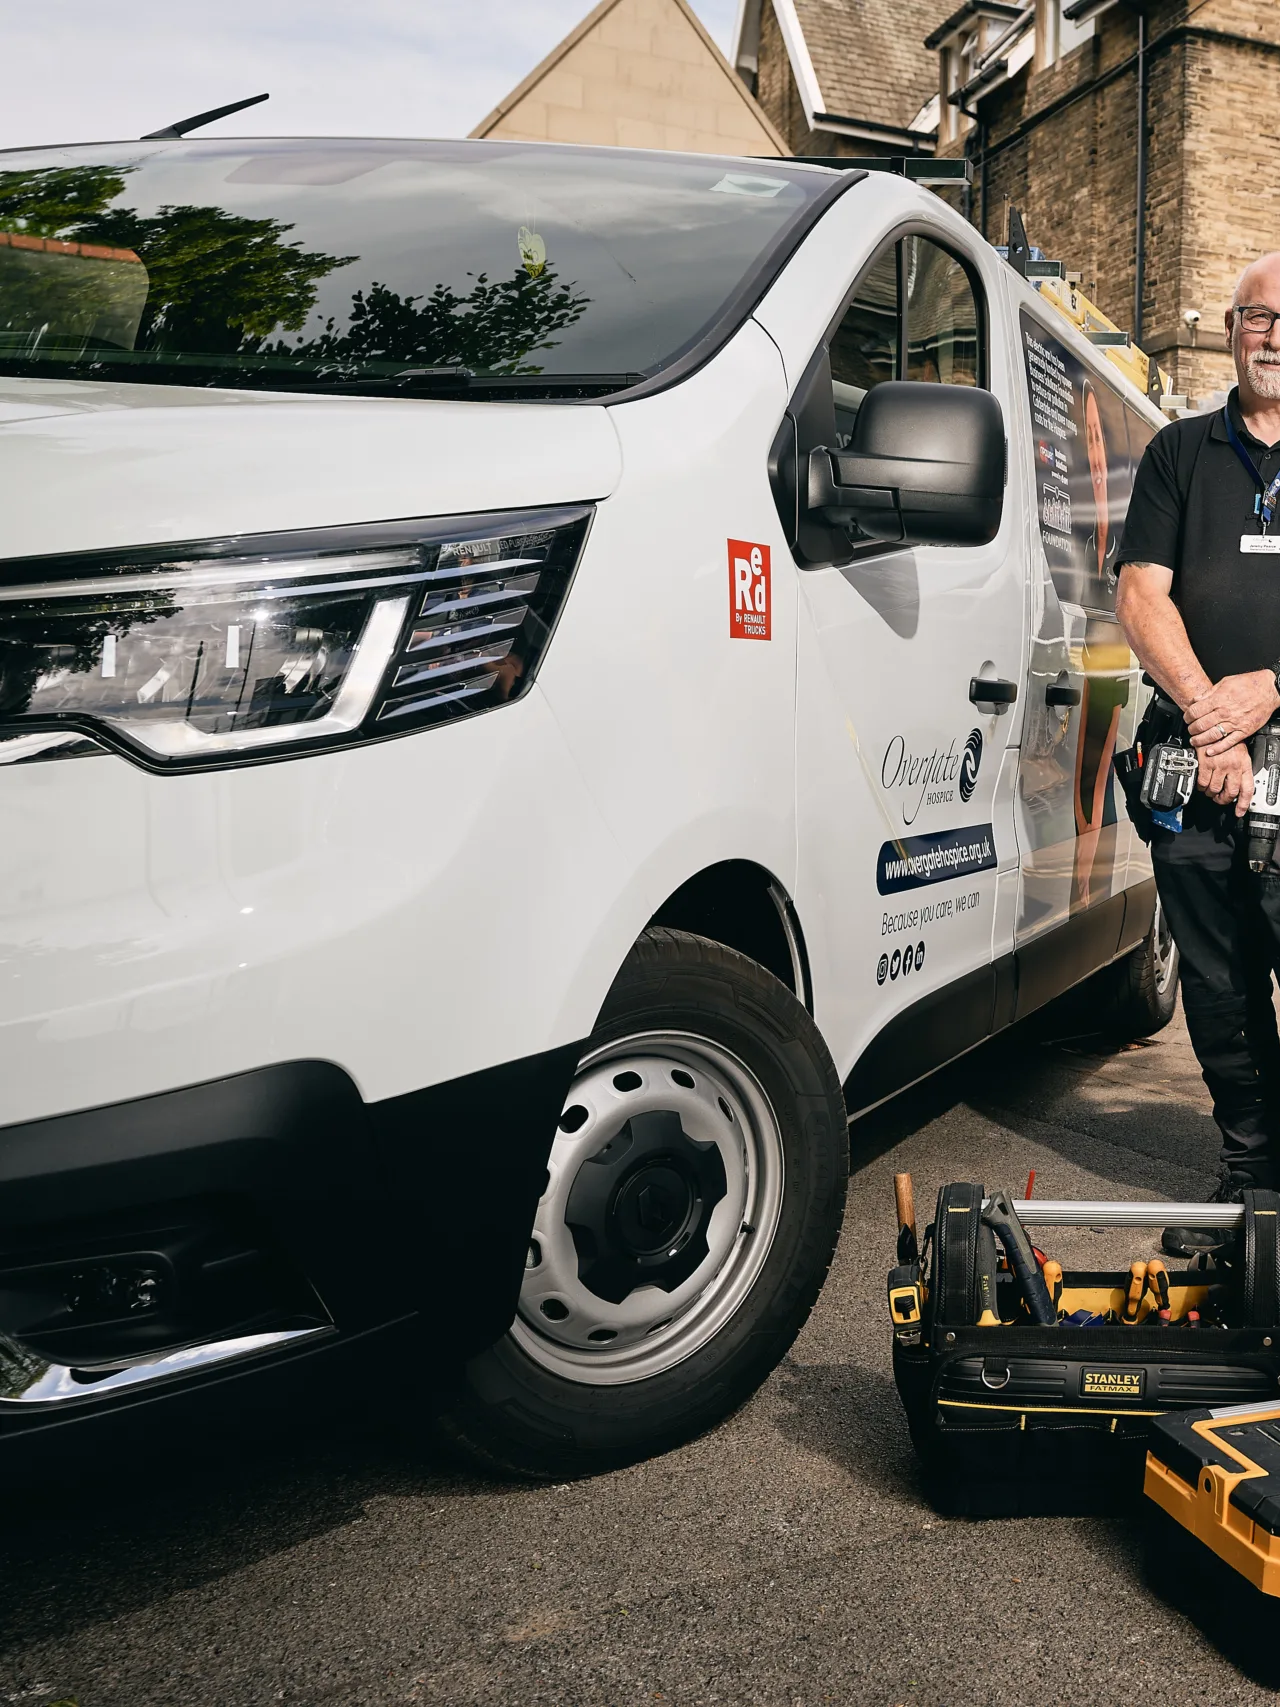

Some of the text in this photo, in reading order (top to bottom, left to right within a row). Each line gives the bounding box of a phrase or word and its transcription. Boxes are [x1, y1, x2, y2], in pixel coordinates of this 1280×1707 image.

[453, 542, 491, 556] RENAULT
[735, 612, 766, 625] By RENAULT
[744, 625, 766, 635] TRUCKS
[882, 735, 960, 826] Overgate
[926, 790, 954, 805] HOSPICE
[885, 836, 992, 880] www.overgatehospice.org.uk
[881, 891, 980, 936] Because you care, we can
[1085, 1373, 1140, 1385] STANLEY
